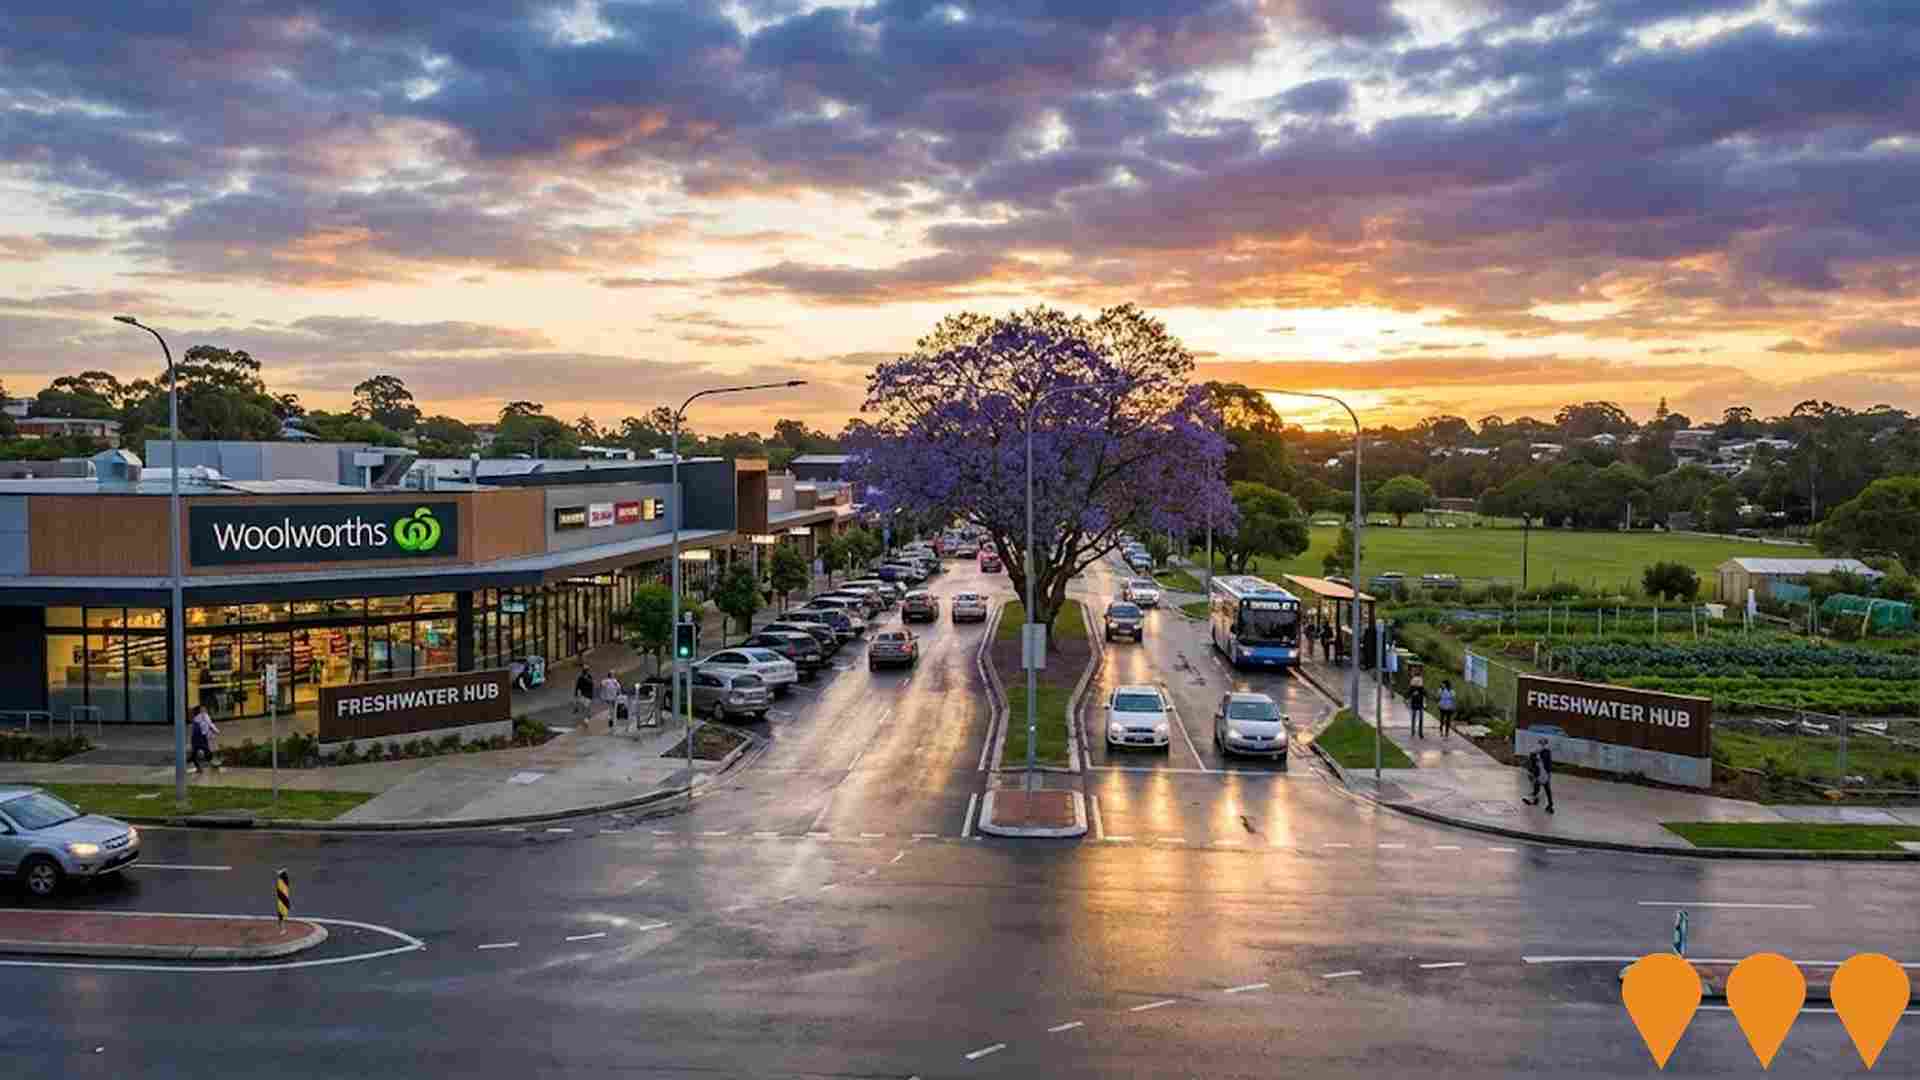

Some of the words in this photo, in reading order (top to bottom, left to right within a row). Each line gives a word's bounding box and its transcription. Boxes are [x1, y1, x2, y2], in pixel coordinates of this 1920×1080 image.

[213, 516, 388, 550] Woolworths
[337, 687, 459, 717] FRESHWATER
[463, 683, 499, 701] HUB
[1527, 690, 1645, 722] FRESHWATER
[1650, 708, 1690, 728] HUB
